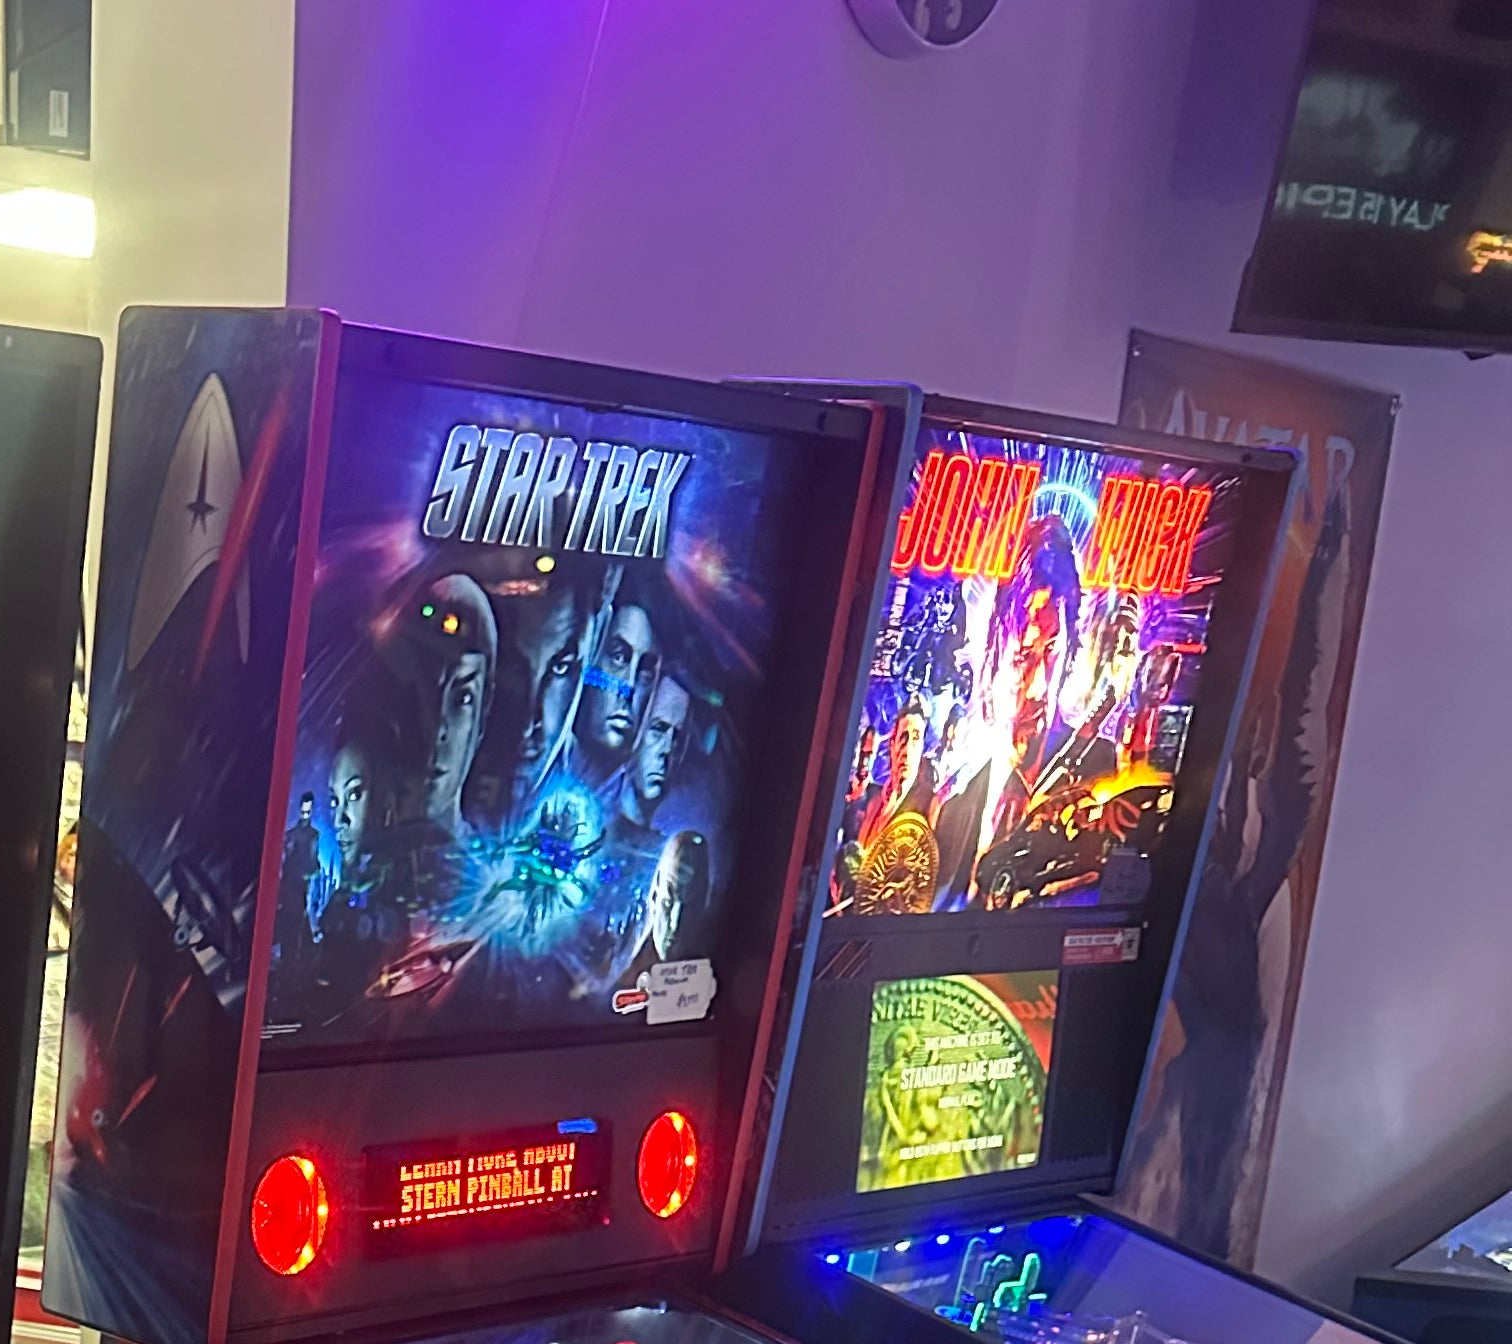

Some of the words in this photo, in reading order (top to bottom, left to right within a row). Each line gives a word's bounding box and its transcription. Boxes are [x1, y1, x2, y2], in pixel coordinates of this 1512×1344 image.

[422, 424, 586, 550] STAR
[563, 438, 693, 560] TREK
[890, 449, 1040, 578] JOHN
[1083, 476, 1213, 596] WICK
[901, 1063, 956, 1090] STANDARD
[958, 1060, 987, 1084] GAME
[988, 1057, 1016, 1080] MODE
[401, 1178, 460, 1213] STERN
[466, 1167, 545, 1204] PINBALL
[551, 1164, 573, 1192] AT
